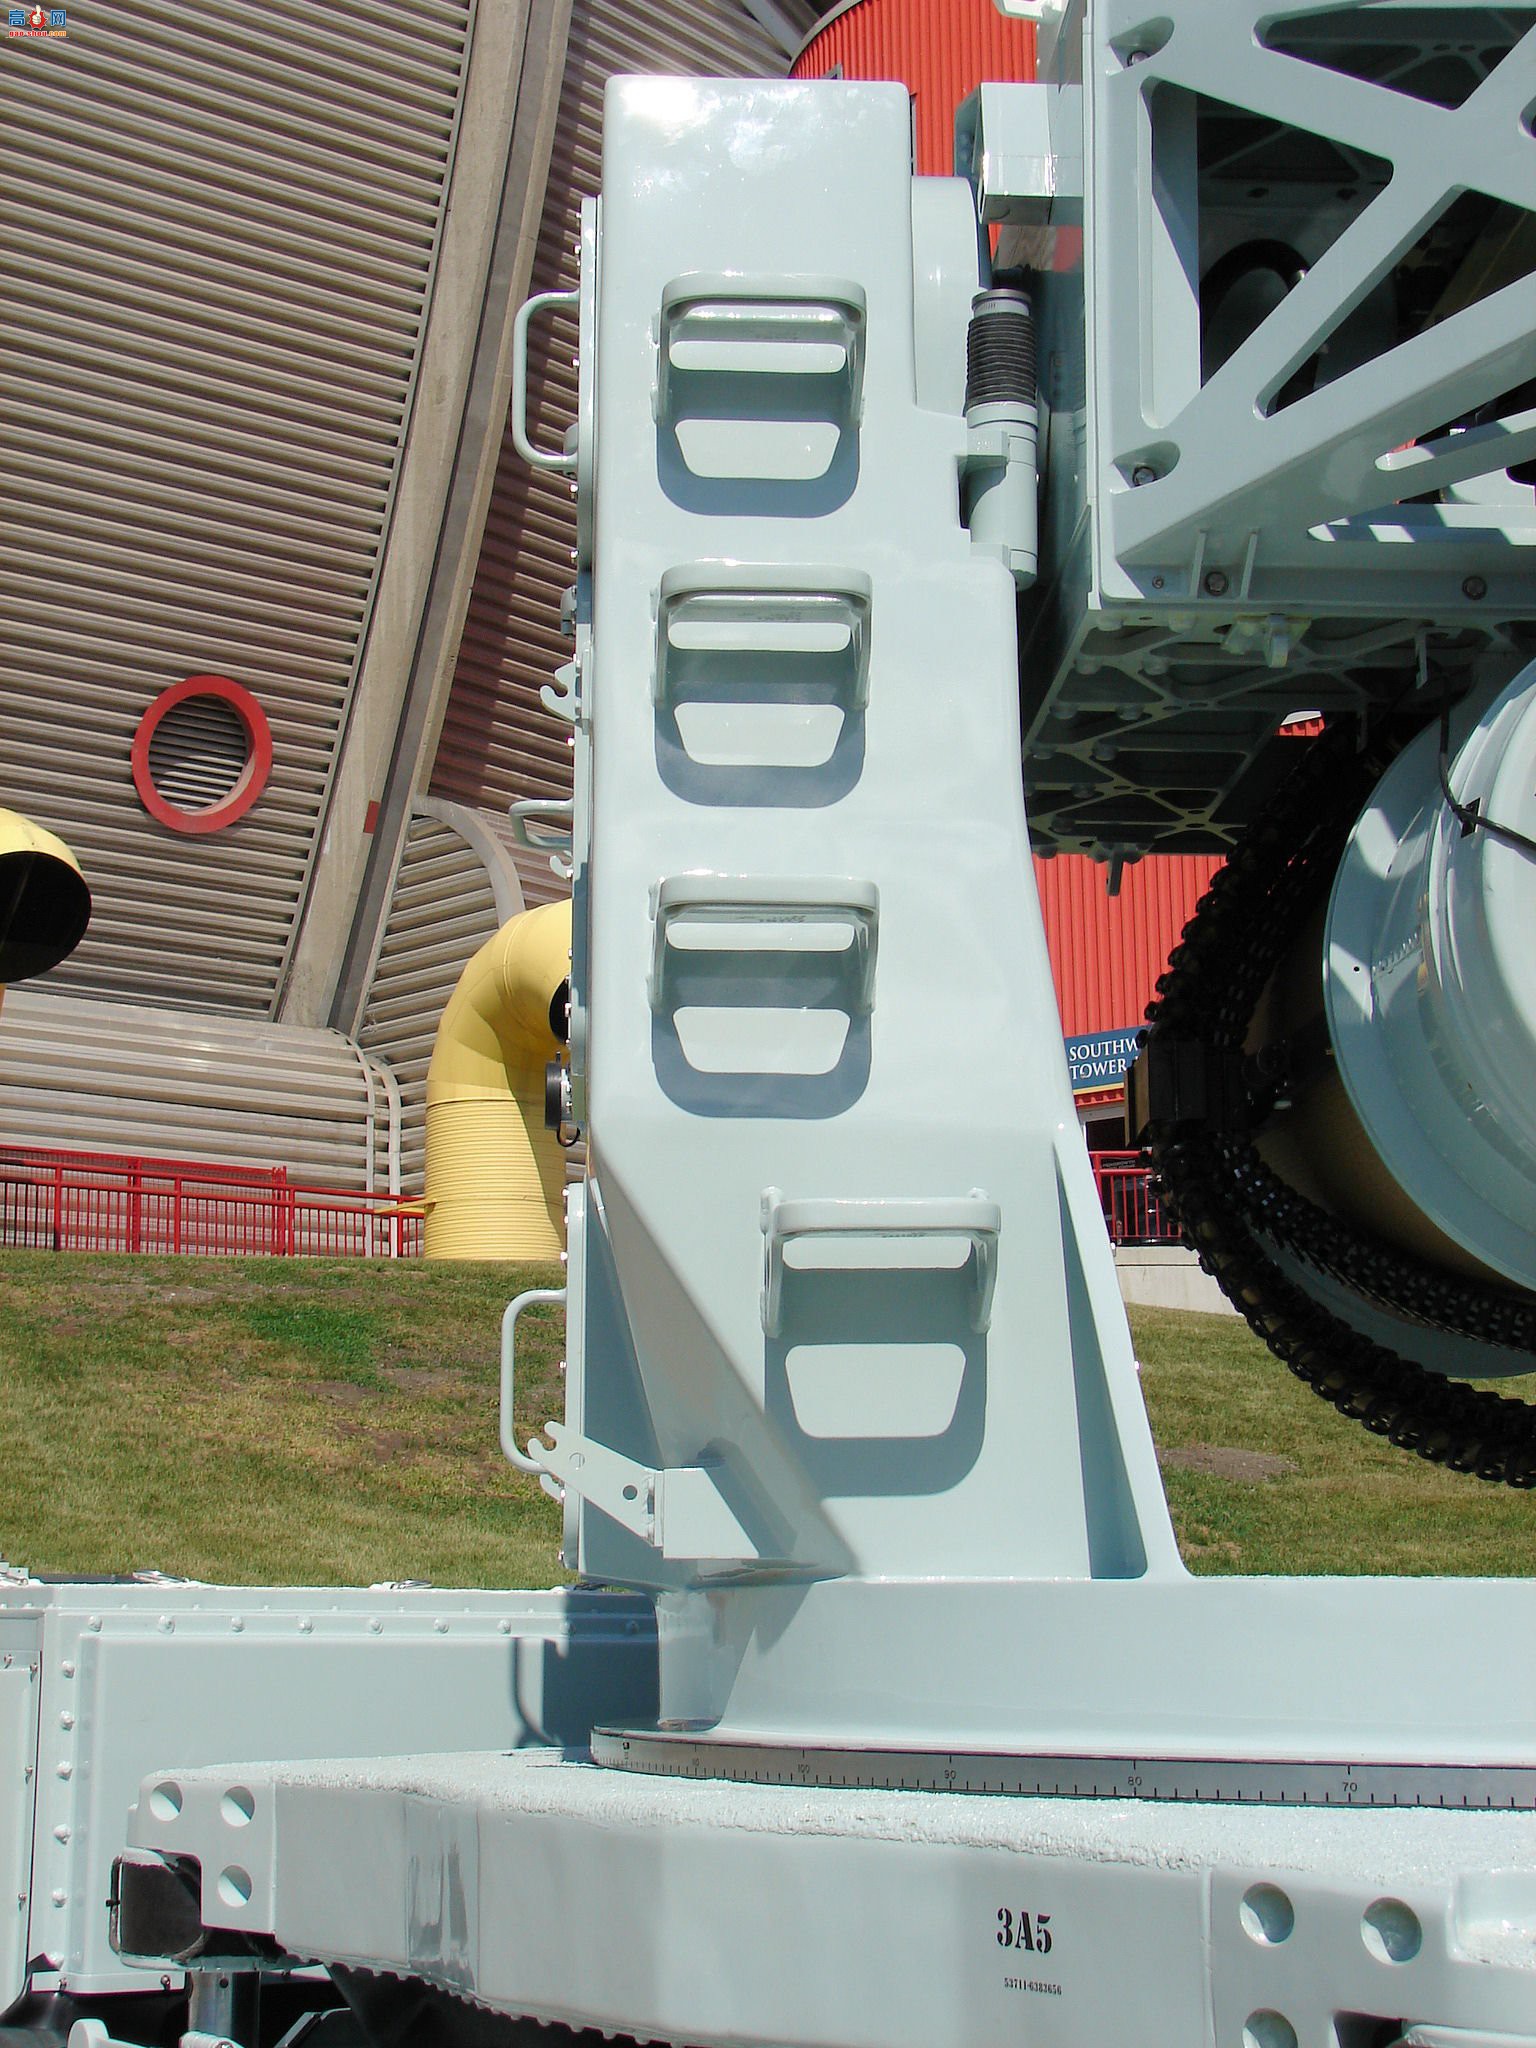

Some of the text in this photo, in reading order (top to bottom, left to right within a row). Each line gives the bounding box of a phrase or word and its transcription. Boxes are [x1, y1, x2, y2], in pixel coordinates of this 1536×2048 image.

[1069, 1037, 1138, 1062] SOUTHW
[1069, 1058, 1127, 1080] TOWER
[797, 1763, 810, 1774] 100
[944, 1769, 957, 1780] 90
[1127, 1775, 1142, 1787] 80
[1342, 1781, 1358, 1793] 70
[996, 1907, 1052, 1954] 3A5
